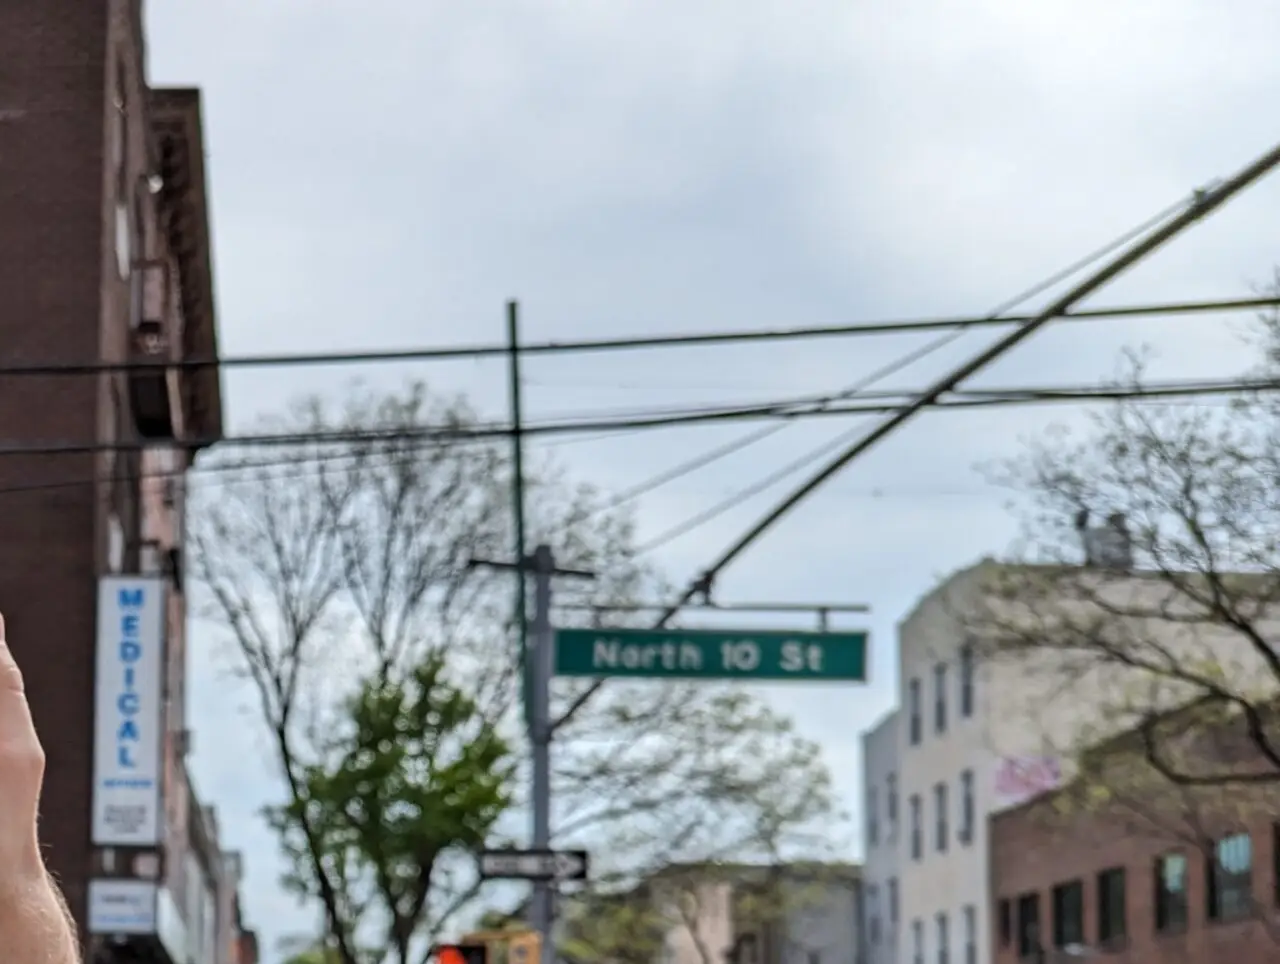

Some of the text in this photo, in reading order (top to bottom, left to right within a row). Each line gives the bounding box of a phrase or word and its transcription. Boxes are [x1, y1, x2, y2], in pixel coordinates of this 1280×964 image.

[117, 588, 144, 768] MEDICAL
[592, 639, 823, 671] North 10 St
